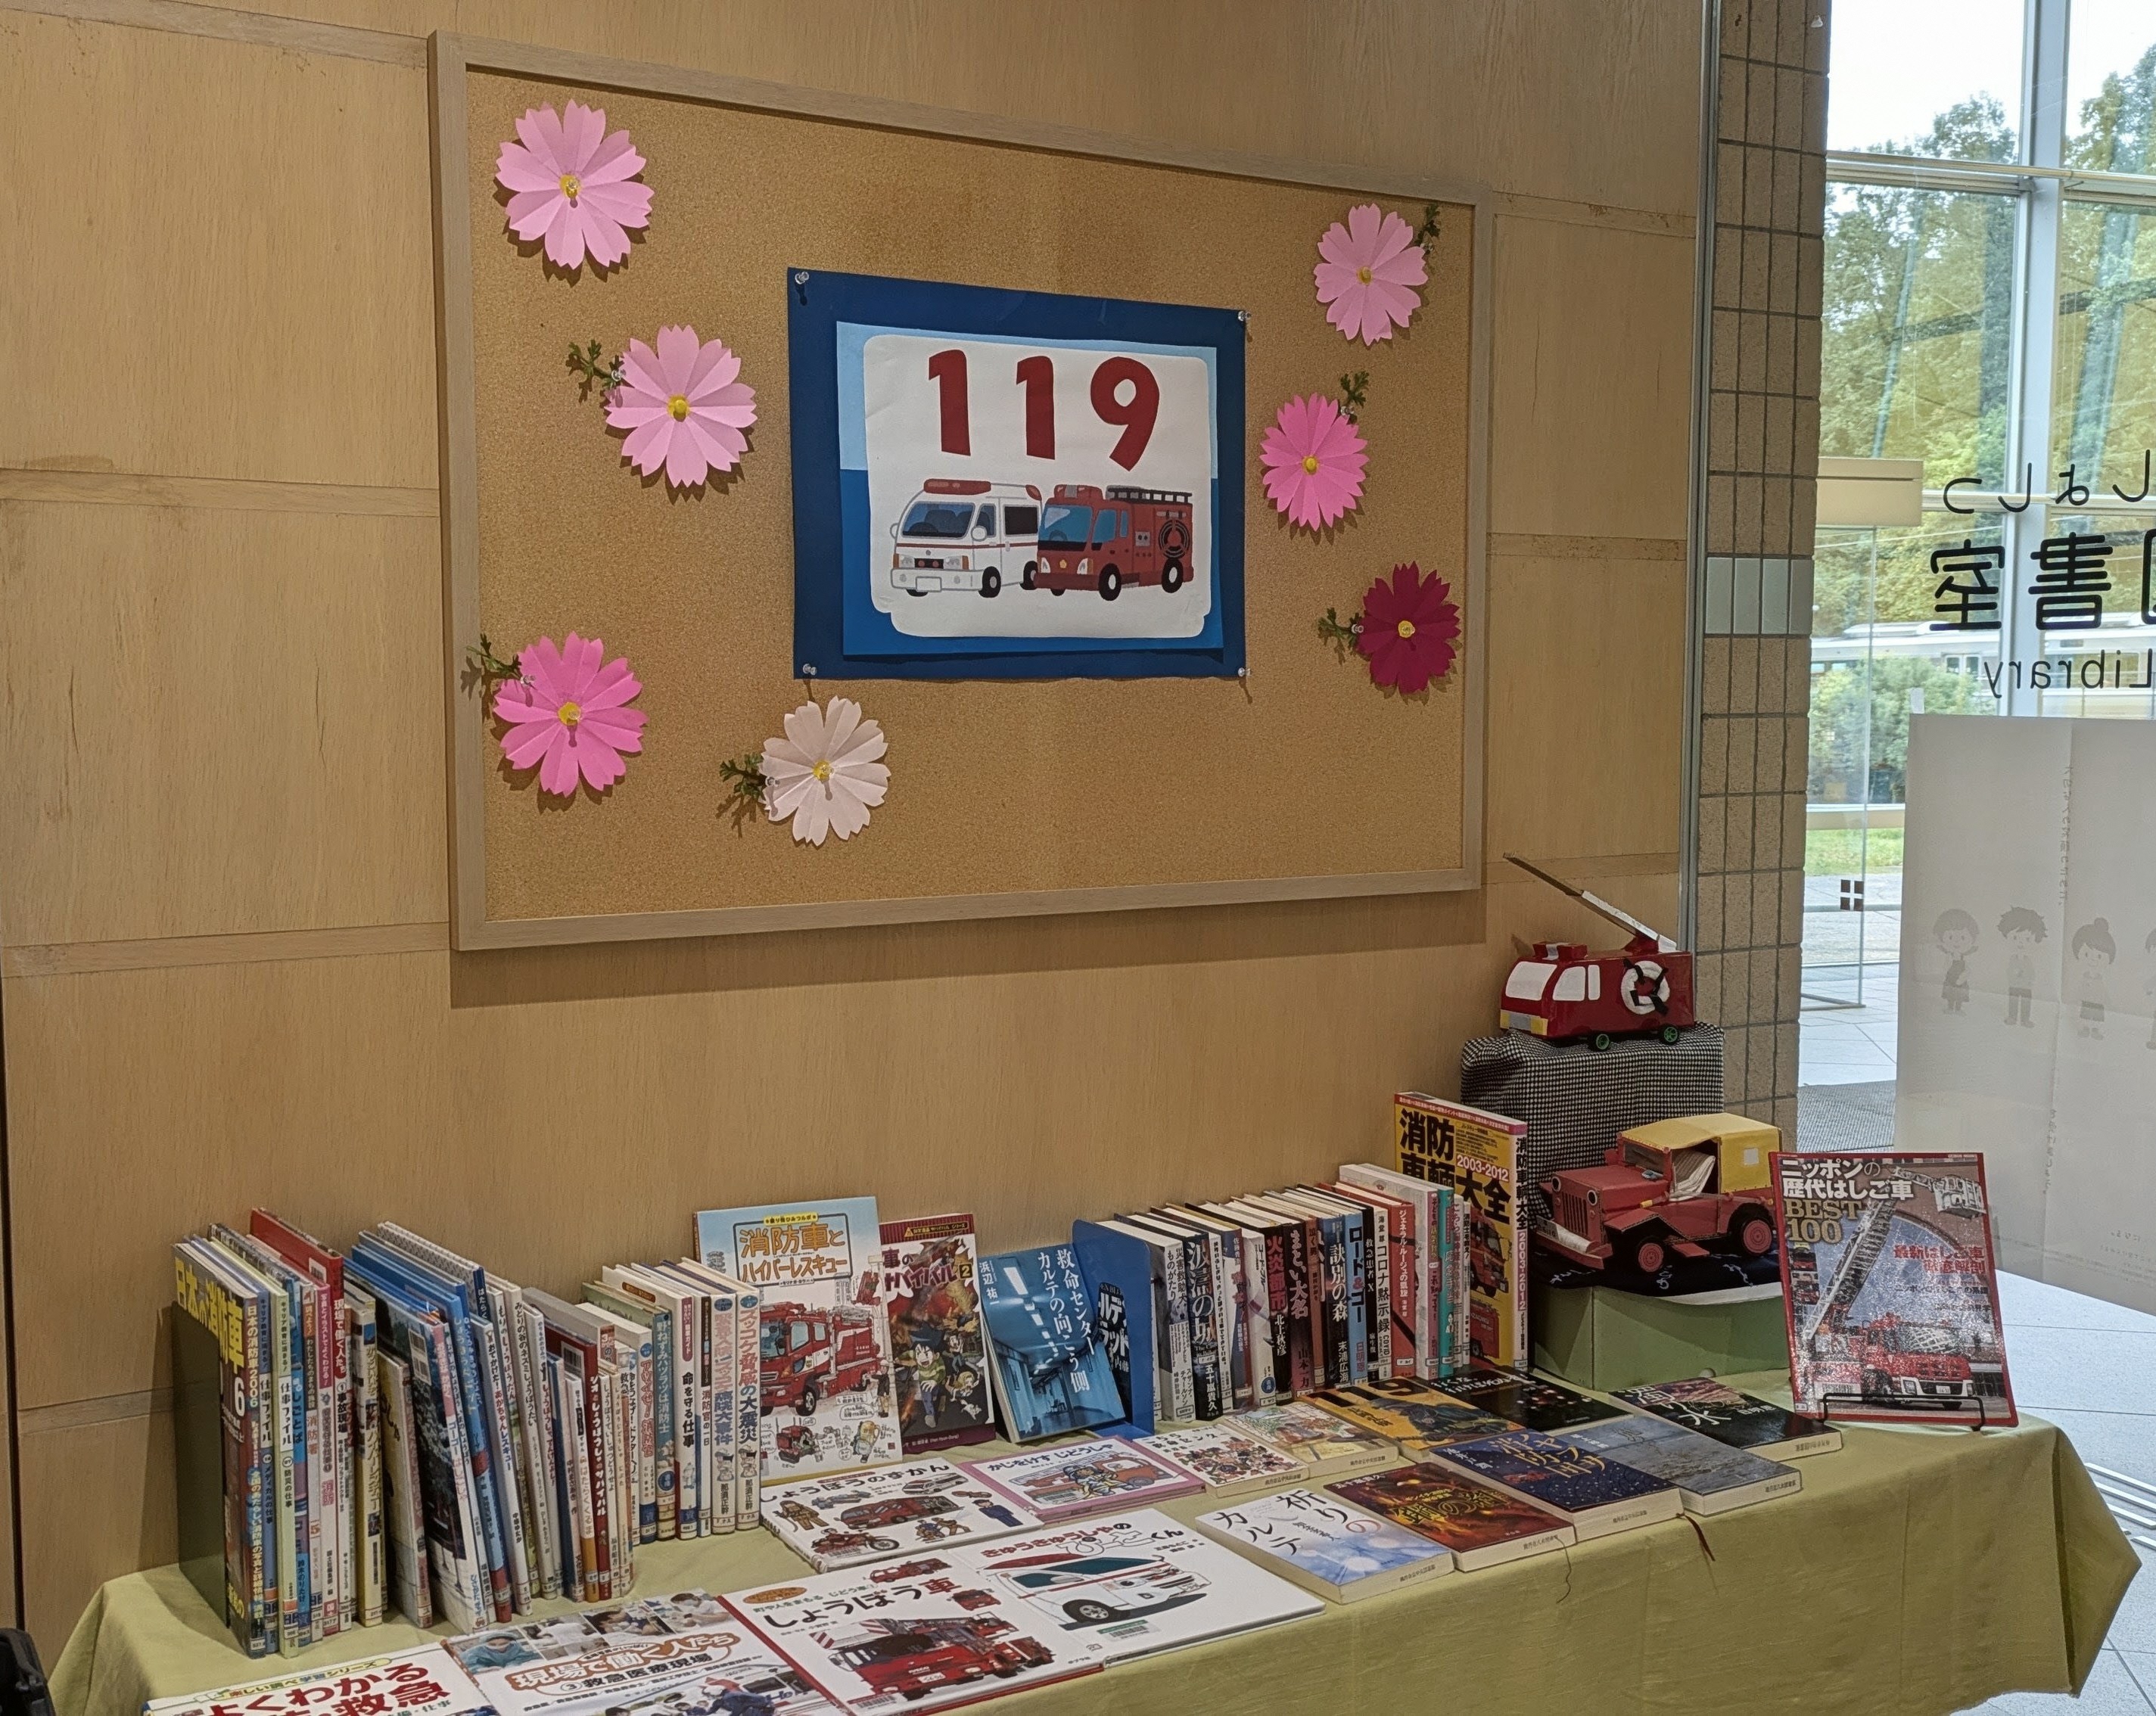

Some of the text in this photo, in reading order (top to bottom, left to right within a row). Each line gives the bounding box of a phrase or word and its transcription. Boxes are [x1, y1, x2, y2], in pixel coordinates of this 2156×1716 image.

[929, 349, 1160, 472] 119
[1399, 1108, 1455, 1162] 消防
[1457, 1154, 1510, 1182] 2003-2012
[1515, 1137, 1528, 1230] 消防車輌大全
[1781, 1158, 1881, 1180] ニッポンの
[1783, 1178, 1914, 1201] 歴代はしご車
[1784, 1199, 1863, 1220] BEST
[1786, 1219, 1843, 1244] 100
[739, 1223, 846, 1258] 消防車と
[1893, 1245, 1986, 1261] 最新はしご車
[741, 1257, 848, 1283] ハイパーレスキュー
[960, 1265, 972, 1278] 2
[978, 1261, 1000, 1305] 浜辺祐一
[1167, 1250, 1177, 1300] ものがたり
[1175, 1248, 1187, 1306] 災害救助犬
[1377, 1245, 1390, 1332] コロナ黙示録
[1037, 1251, 1090, 1394] カルテの向こう側
[1056, 1248, 1095, 1355] 救命センター
[1187, 1239, 1216, 1346] 波濤の城
[1205, 1363, 1218, 1412] 五十嵐貴久
[1289, 1229, 1310, 1389] まとい大名 山本一力
[246, 1304, 259, 1408] 日本の消防車2006
[334, 1299, 347, 1374] 現場で働く人たち
[1274, 1314, 1286, 1357] 北上秋彦
[656, 1320, 671, 1435] 野ねずみハツラツは消防士
[260, 1376, 272, 1442] 仕事ファイル
[280, 1382, 292, 1445] 仕事ファイル
[682, 1371, 695, 1447] 命を守る仕事
[702, 1389, 711, 1447] 消防官の一日
[738, 1310, 758, 1510] ズッコケ脅威の大震災 那須正幹
[761, 1462, 950, 1503] しょうぼうのずかん
[987, 1444, 1114, 1472] かじをけす じどうしゃ
[720, 1483, 730, 1515] 那須正幹
[1275, 1489, 1382, 1534] 祈りの
[981, 1522, 1132, 1559] きゅうきゅうしゃの
[1213, 1510, 1301, 1556] カルテ
[763, 1578, 963, 1629] しょうぼう車
[229, 1660, 381, 1699] 楽しい調べ学習シリーズ
[512, 1633, 734, 1688] 現場で働く人たち
[205, 1663, 430, 1716] よくわかる
